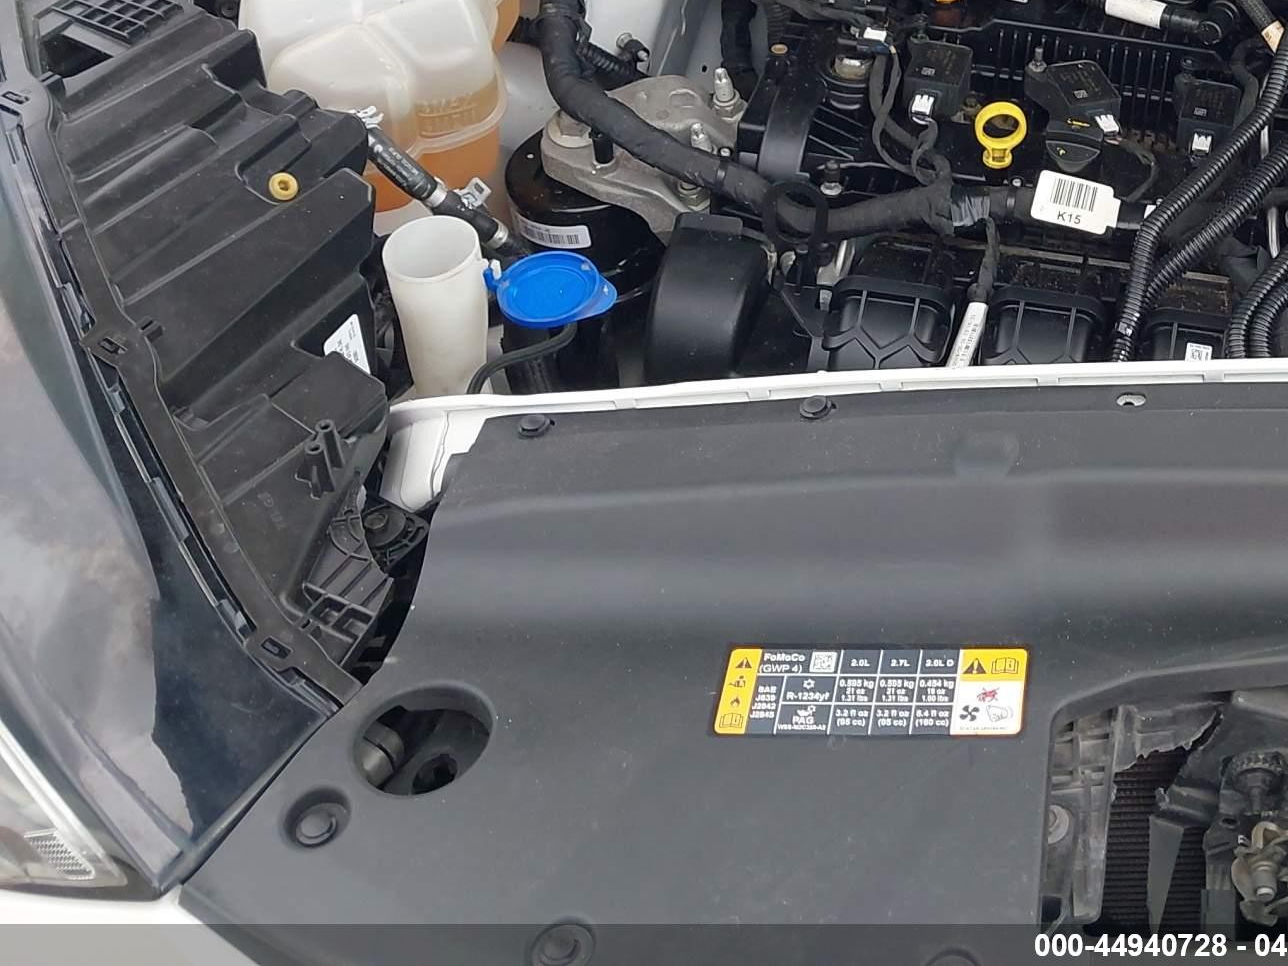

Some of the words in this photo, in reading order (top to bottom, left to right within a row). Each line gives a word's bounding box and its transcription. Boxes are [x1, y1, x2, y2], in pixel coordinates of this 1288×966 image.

[1056, 210, 1082, 225] K15
[763, 653, 806, 662] FoMoCo
[850, 659, 871, 667] 2.0L
[890, 659, 910, 667] 2.7L
[759, 664, 790, 674] (GWP
[791, 664, 803, 674] 4)
[863, 679, 875, 690] kg
[903, 679, 915, 690] kg
[943, 679, 955, 690] kg
[786, 692, 830, 702] R-1234yf
[792, 715, 815, 725] PAG
